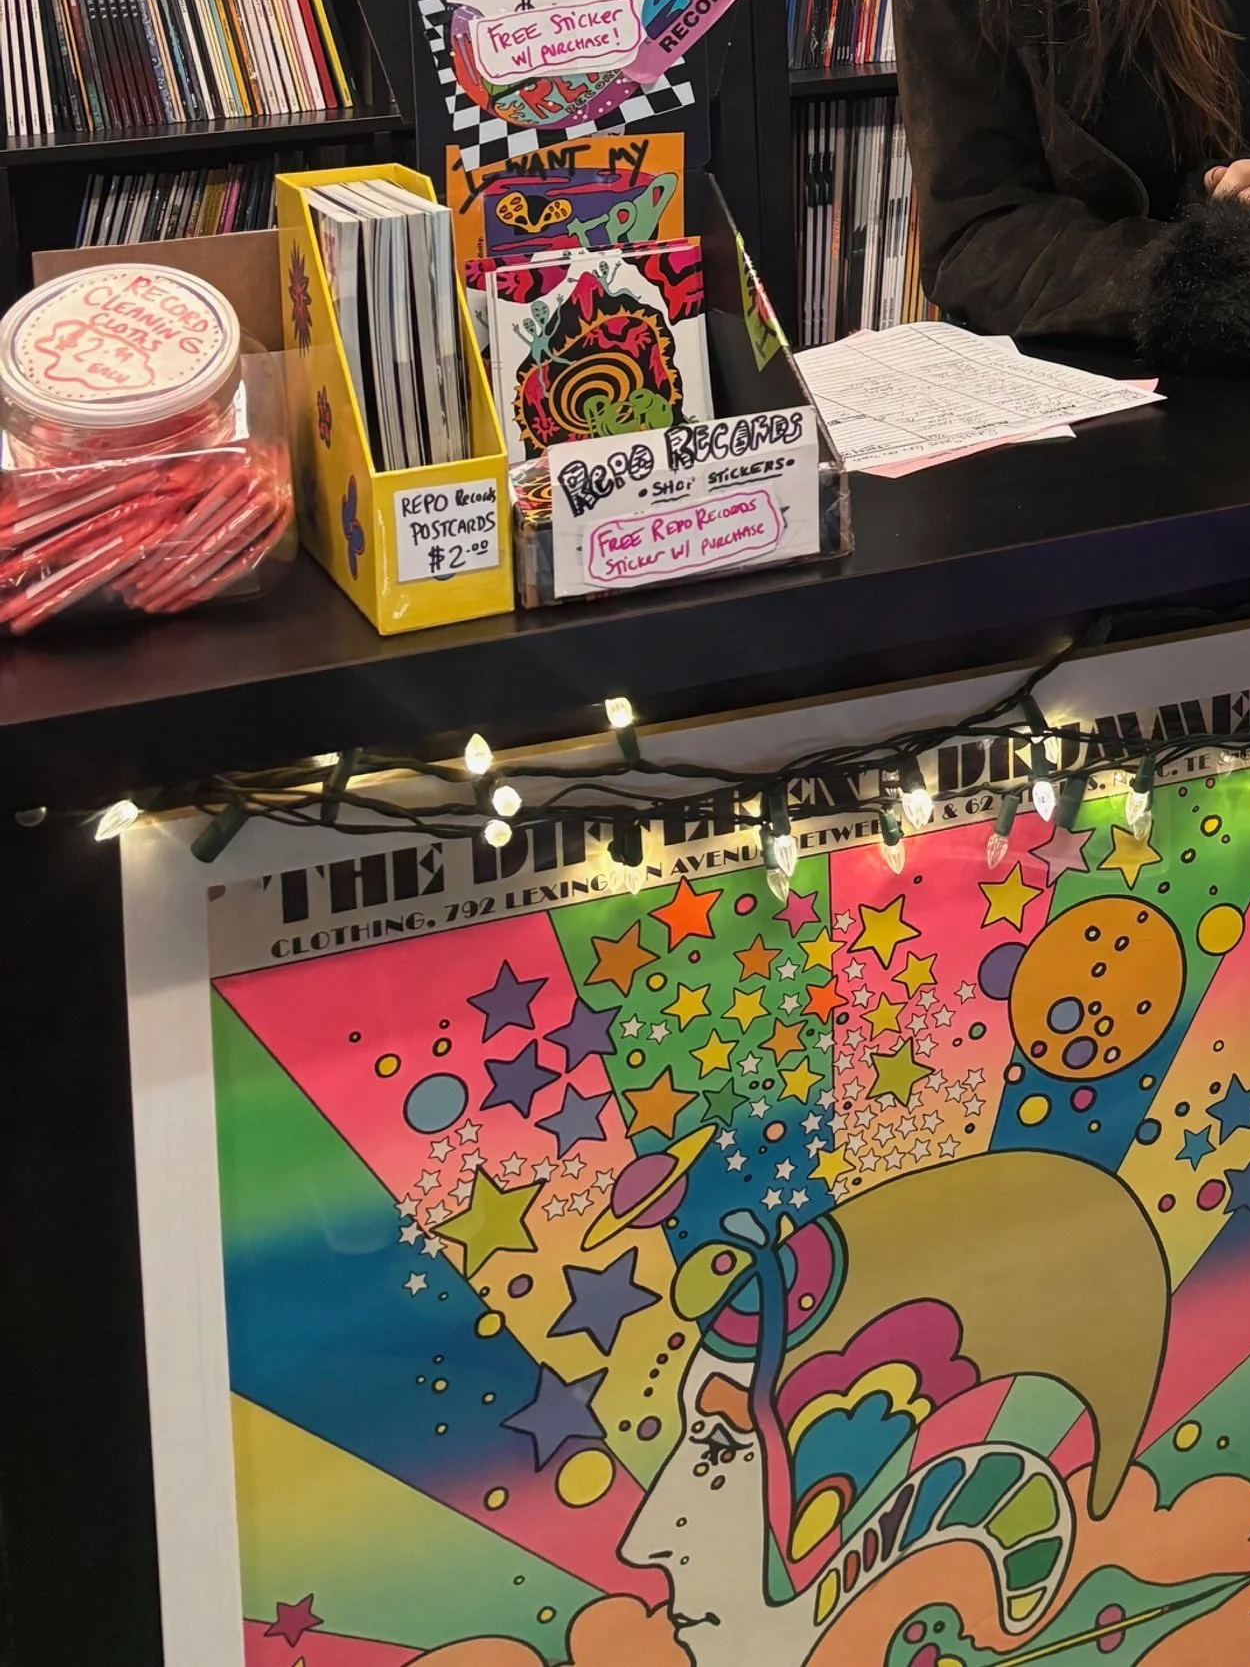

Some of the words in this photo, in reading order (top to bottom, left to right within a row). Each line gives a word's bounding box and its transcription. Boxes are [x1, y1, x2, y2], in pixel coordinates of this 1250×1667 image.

[487, 22, 542, 54] FREE
[506, 143, 591, 176] WANT
[609, 139, 649, 187] MY
[83, 286, 204, 355] CLEANING
[122, 275, 209, 333] RECORD
[88, 312, 163, 352] CLOTHS
[87, 363, 130, 384] EACH
[558, 443, 655, 518] Repo
[665, 411, 803, 472] RECORDS
[401, 492, 447, 518] REPO
[454, 487, 497, 507] Records
[409, 511, 496, 546] POSTCARDS
[598, 525, 643, 558] FREE
[651, 515, 693, 543] REPO
[696, 498, 758, 531] RECORDS
[700, 521, 766, 557] PURCHASE
[427, 539, 489, 574] $2.00
[444, 896, 496, 926] 792
[670, 845, 765, 877] AVENU
[941, 802, 958, 820] &
[965, 794, 995, 814] 62
[264, 842, 446, 925] THE
